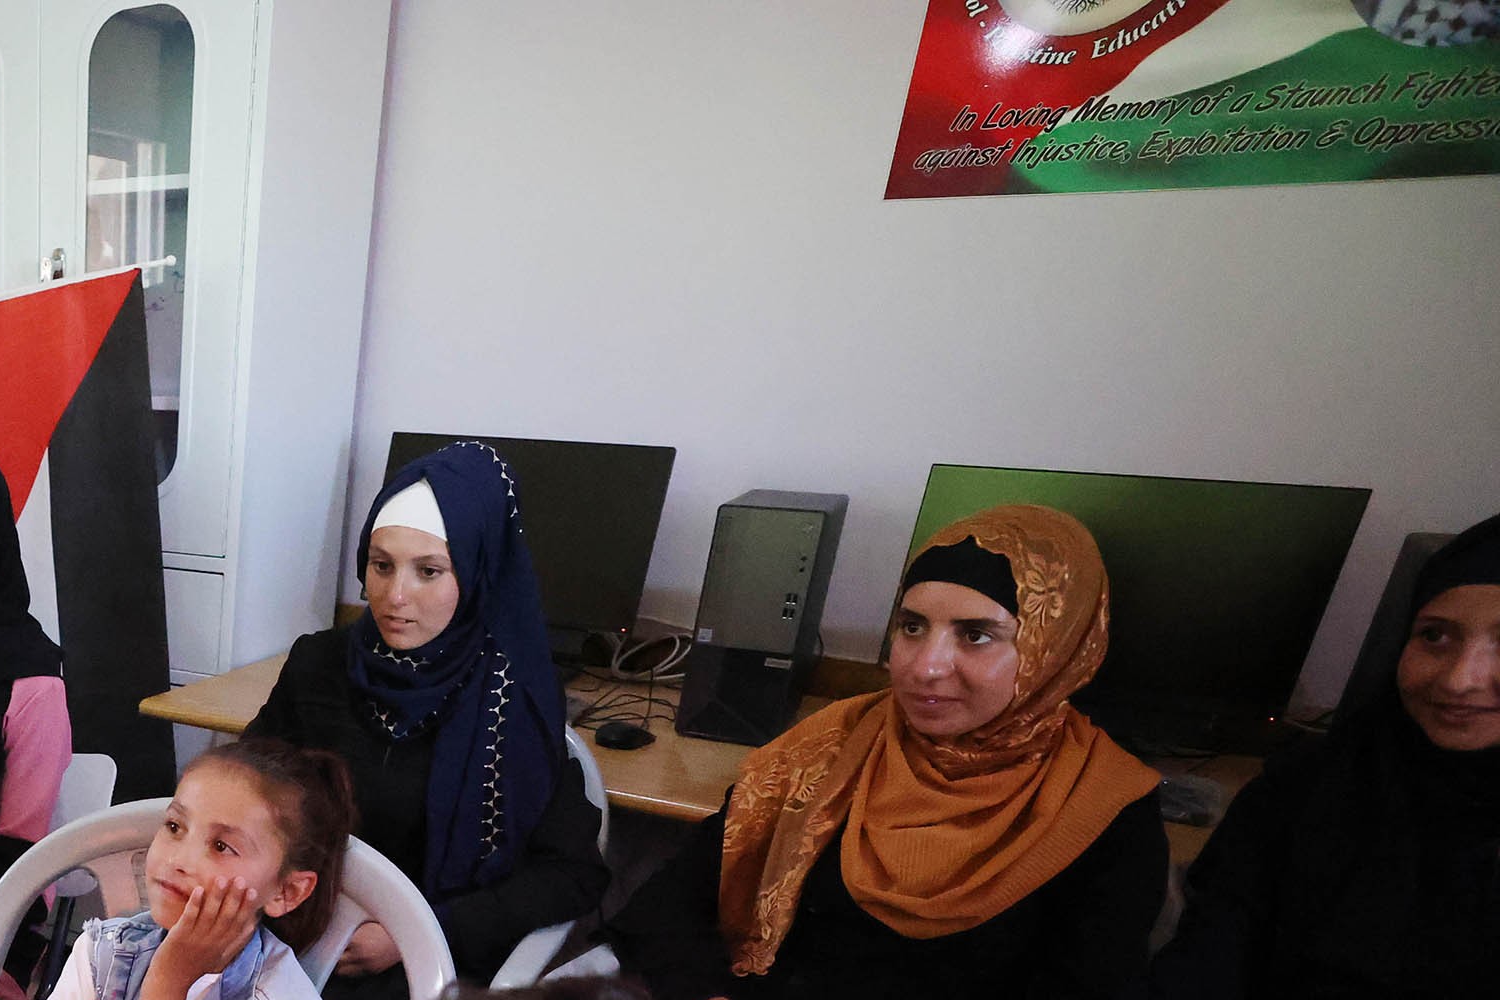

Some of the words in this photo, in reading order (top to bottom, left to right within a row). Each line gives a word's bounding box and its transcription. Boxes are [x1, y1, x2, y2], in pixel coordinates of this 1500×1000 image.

[950, 105, 977, 132] In
[981, 102, 1069, 134] Loving
[1071, 95, 1191, 126] Memory
[1190, 85, 1235, 117] of
[1229, 92, 1254, 113] a
[1255, 73, 1389, 112] Staunch
[1391, 66, 1500, 110] Fighte
[913, 138, 1013, 177] against
[1008, 134, 1131, 170] Injustice,
[1138, 122, 1311, 164] Exploitation
[1315, 119, 1350, 149] &
